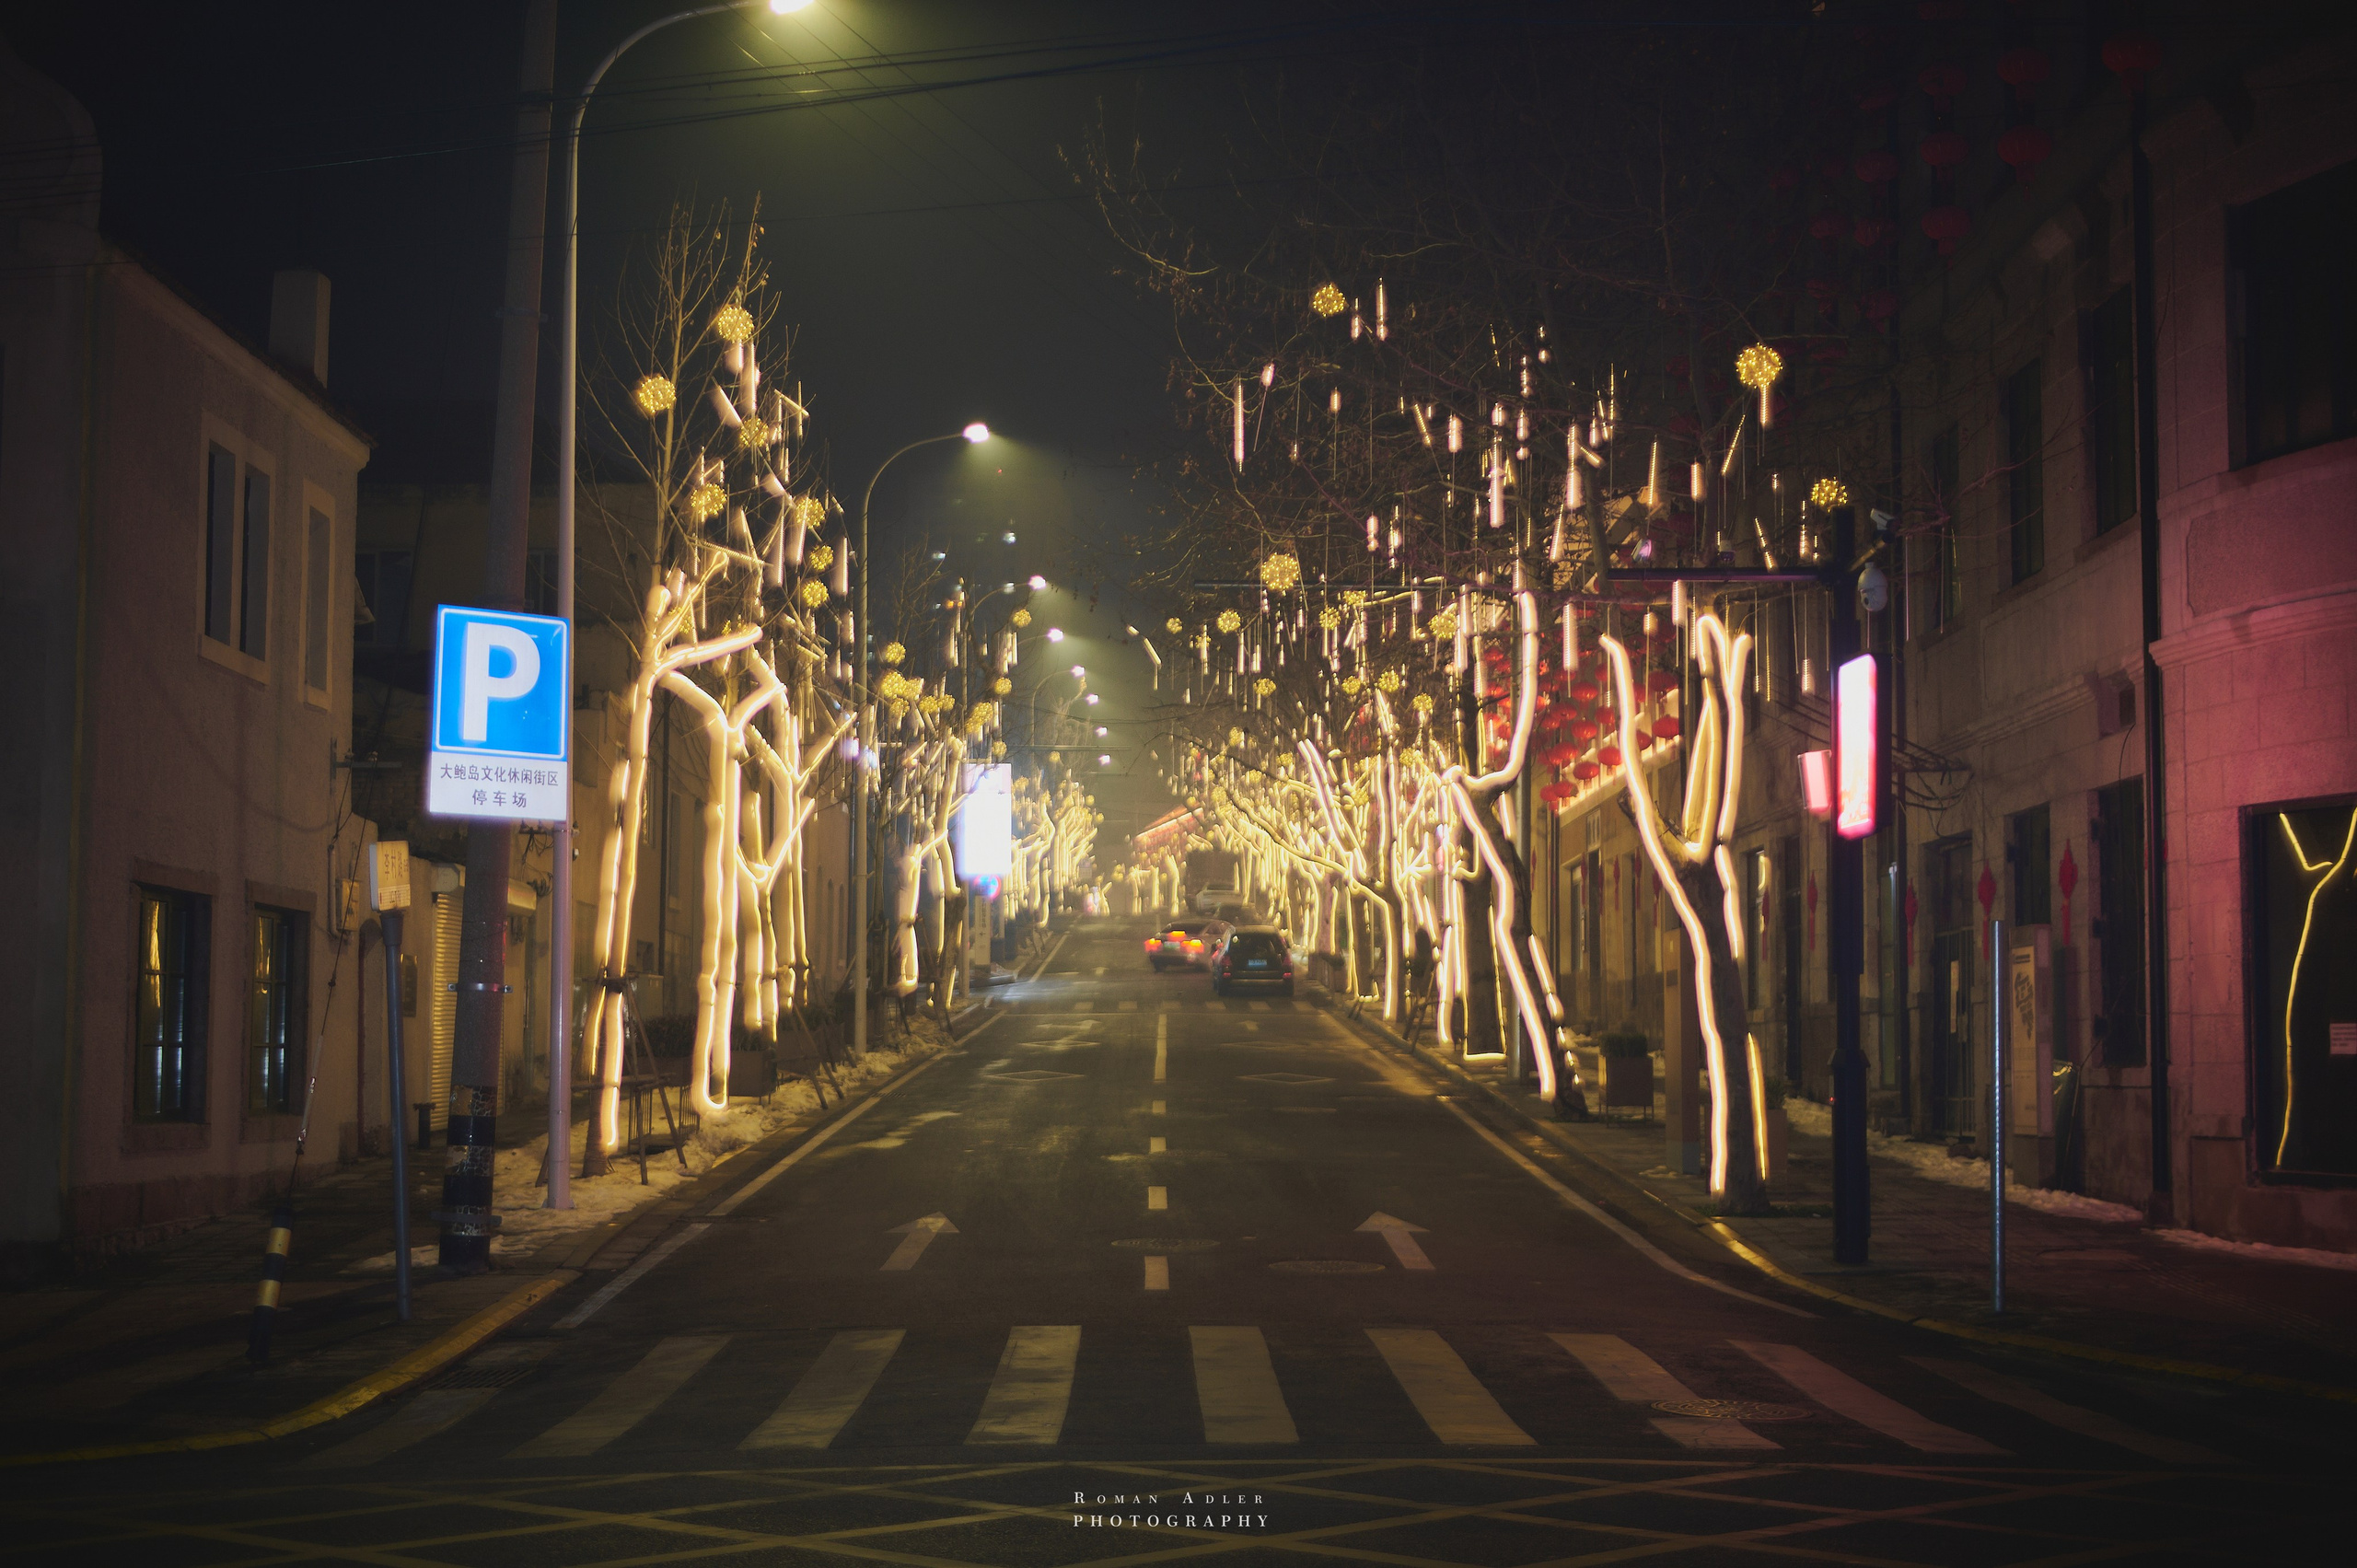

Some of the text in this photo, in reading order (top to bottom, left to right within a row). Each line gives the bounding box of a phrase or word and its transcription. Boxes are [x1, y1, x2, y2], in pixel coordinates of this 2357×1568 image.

[463, 621, 540, 742] P
[440, 762, 559, 786] 大鲍岛文化休闲街区
[471, 789, 528, 808] 停车场
